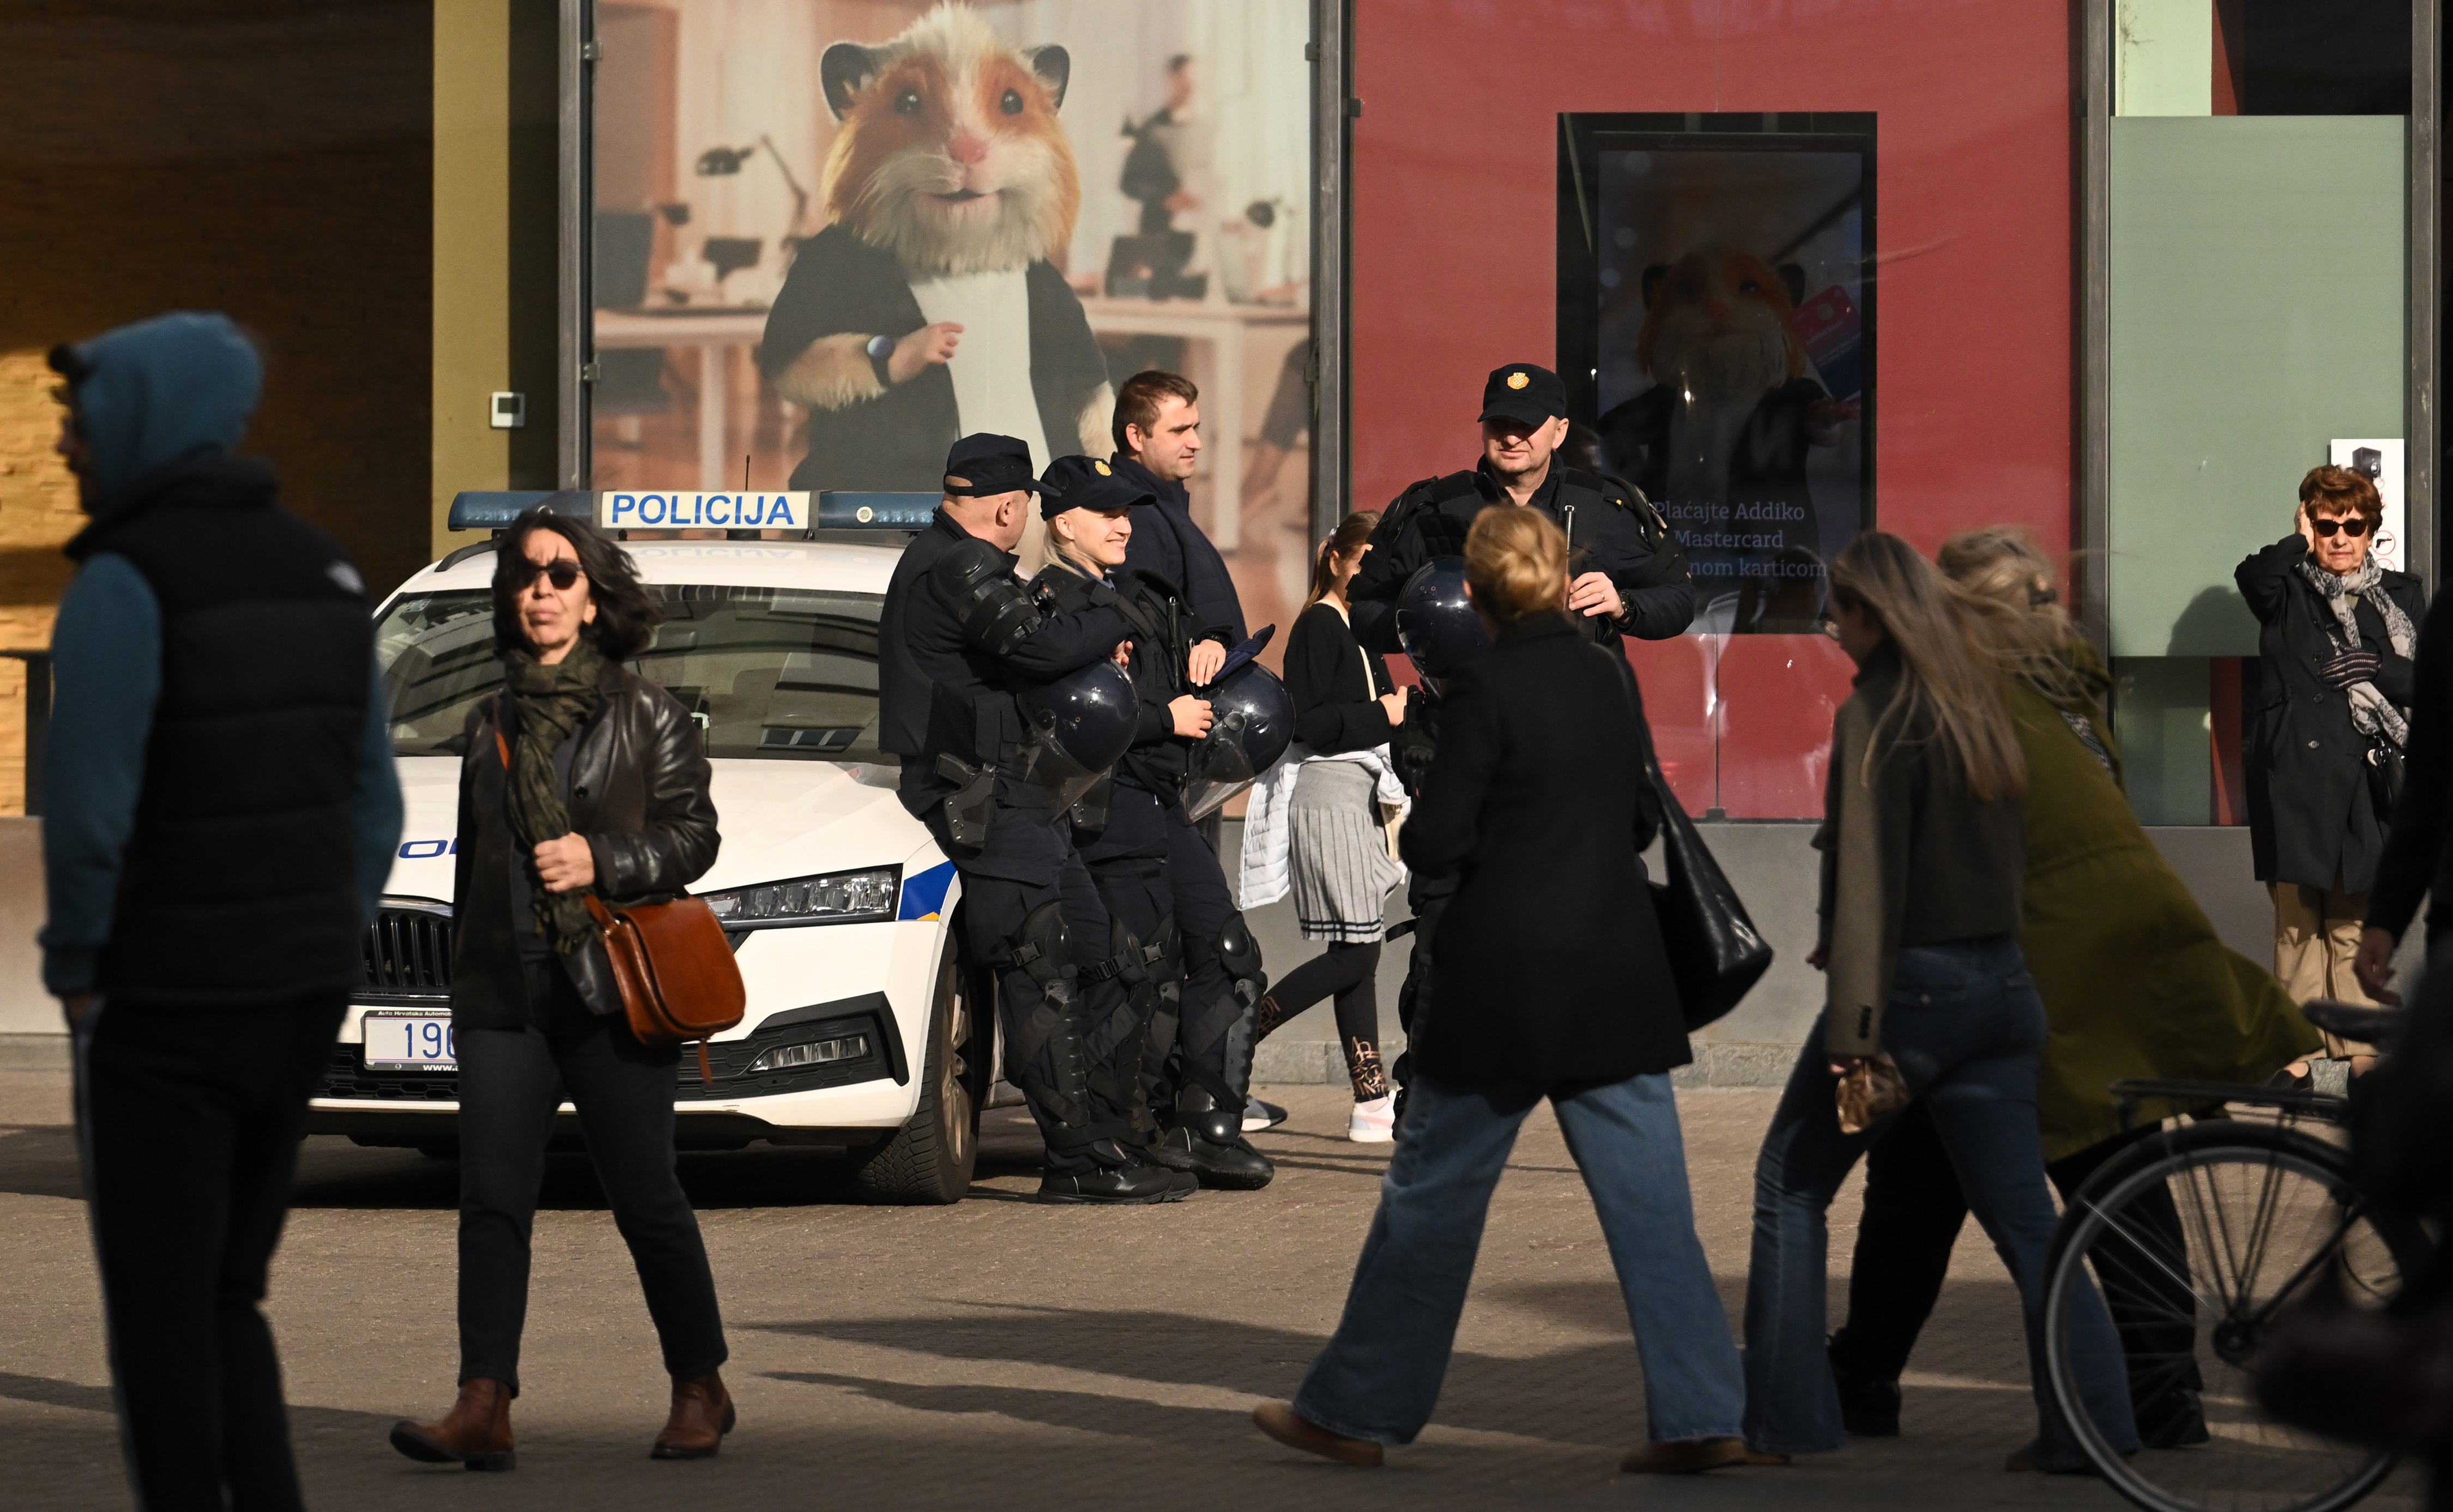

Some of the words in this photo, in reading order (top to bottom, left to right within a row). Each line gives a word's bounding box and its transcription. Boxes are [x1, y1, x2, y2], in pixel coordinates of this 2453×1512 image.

[612, 494, 794, 525] POLICIJA
[1652, 500, 1730, 524] Plaćajte
[1734, 501, 1805, 520] Addiko
[1674, 529, 1784, 548] Mastercard
[1738, 558, 1828, 576] karticom
